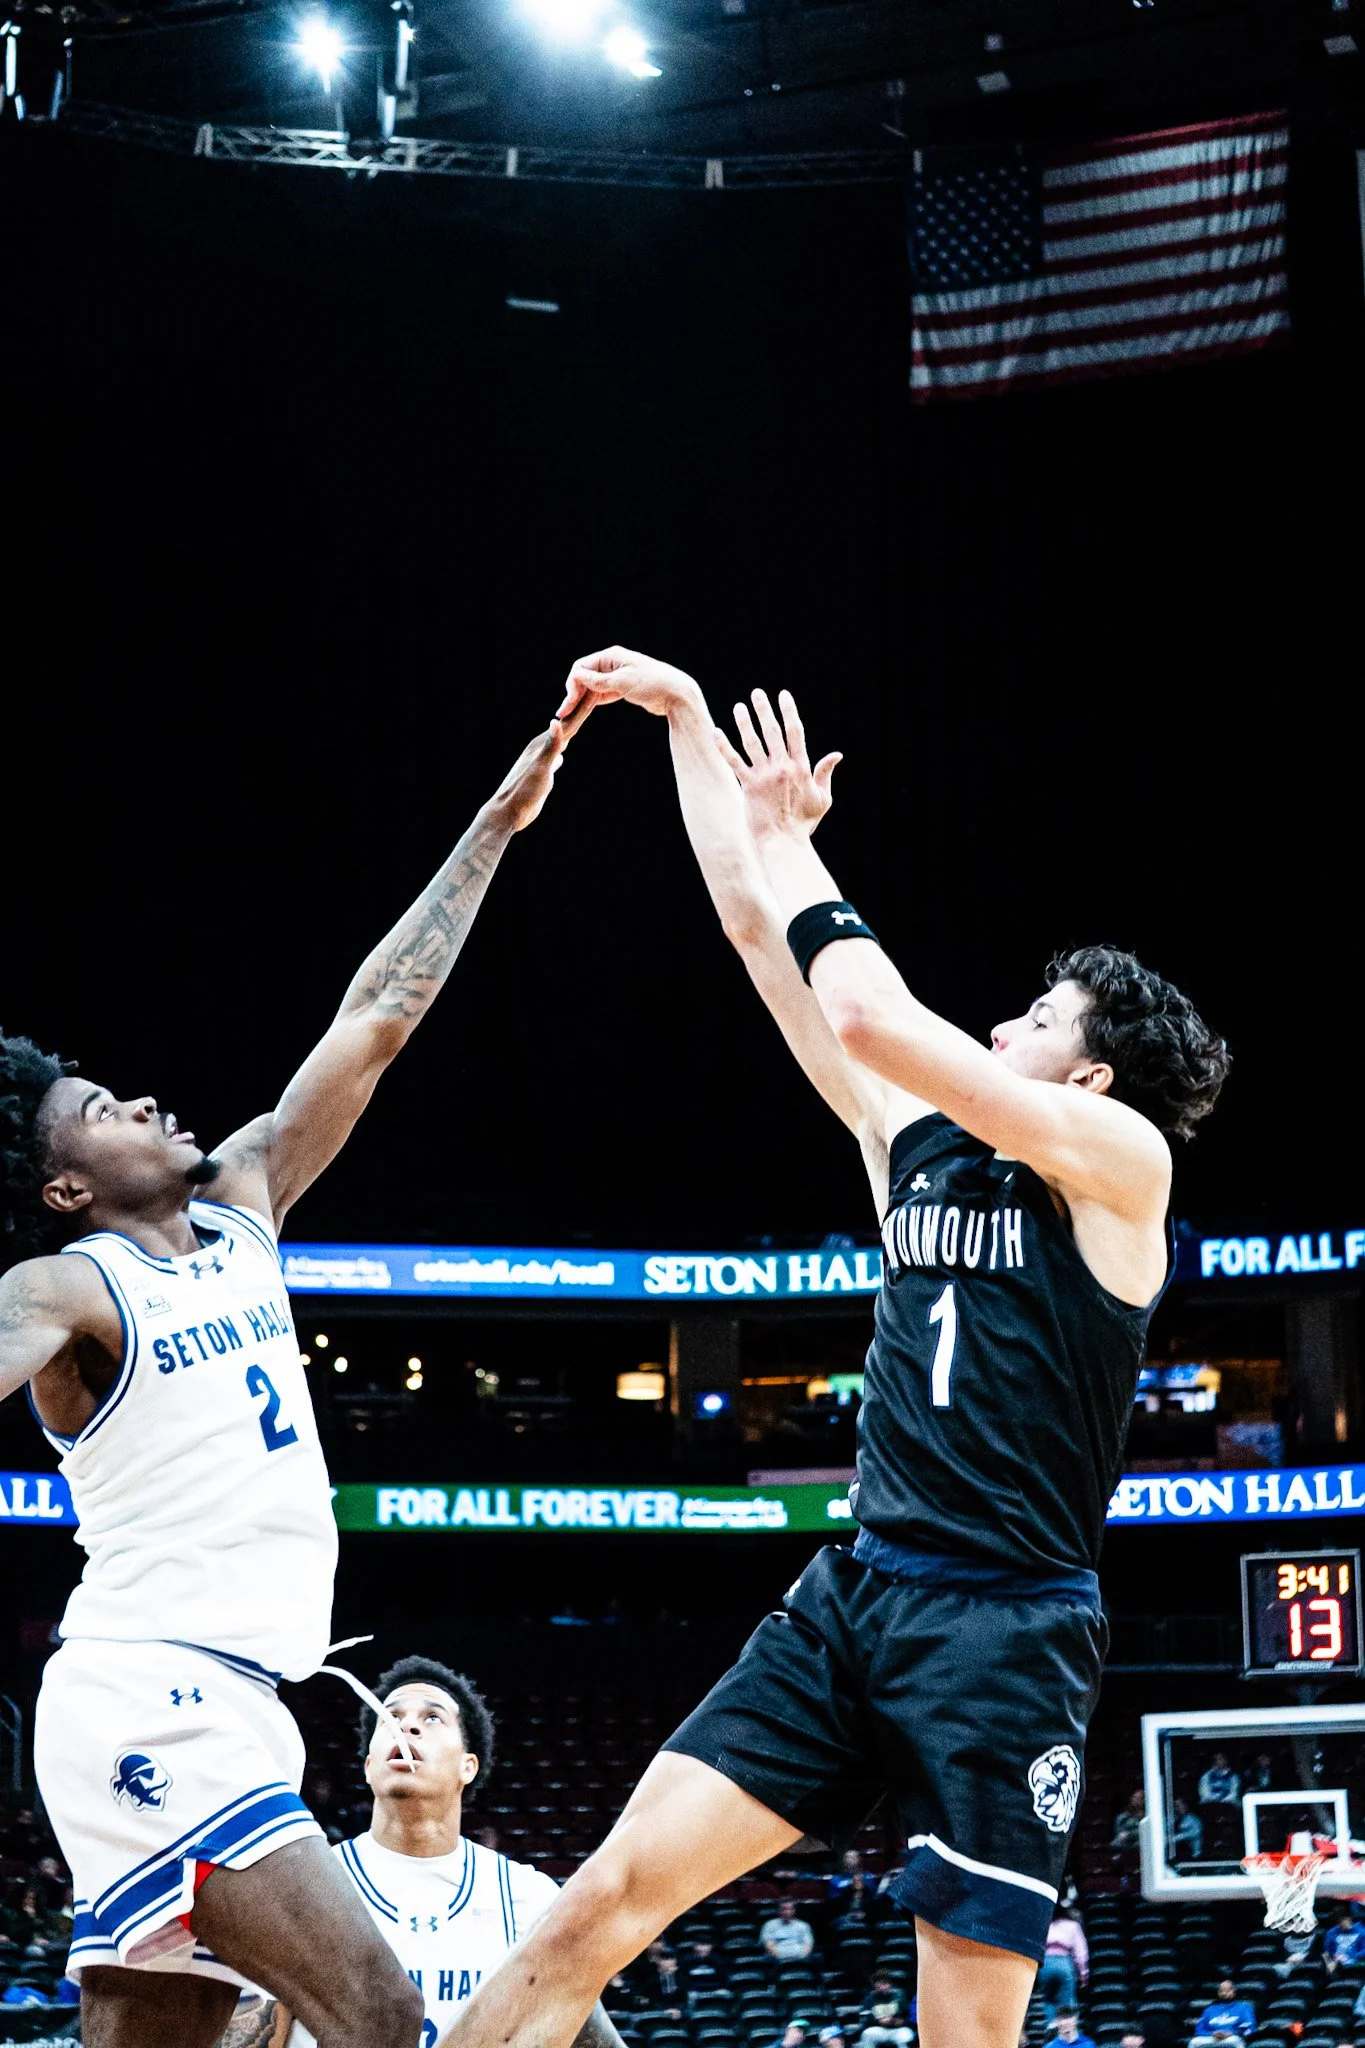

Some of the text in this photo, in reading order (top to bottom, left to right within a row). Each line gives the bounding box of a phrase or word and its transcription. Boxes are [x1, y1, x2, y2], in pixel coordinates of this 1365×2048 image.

[881, 1205, 1024, 1269] MONMOUTH
[1200, 1237, 1271, 1277] FOR
[1274, 1231, 1343, 1274] ALL
[644, 1256, 777, 1295] SETON
[788, 1252, 883, 1293] HAL
[152, 1315, 243, 1375] SETON
[929, 1283, 957, 1408] 1
[246, 1364, 299, 1452] 2
[376, 1487, 448, 1526] FOR
[451, 1488, 521, 1526] ALL
[521, 1489, 680, 1528] FOREVER
[1244, 1470, 1365, 1513] HALL
[1277, 1563, 1350, 1600] 3:41
[1288, 1598, 1342, 1660] 13
